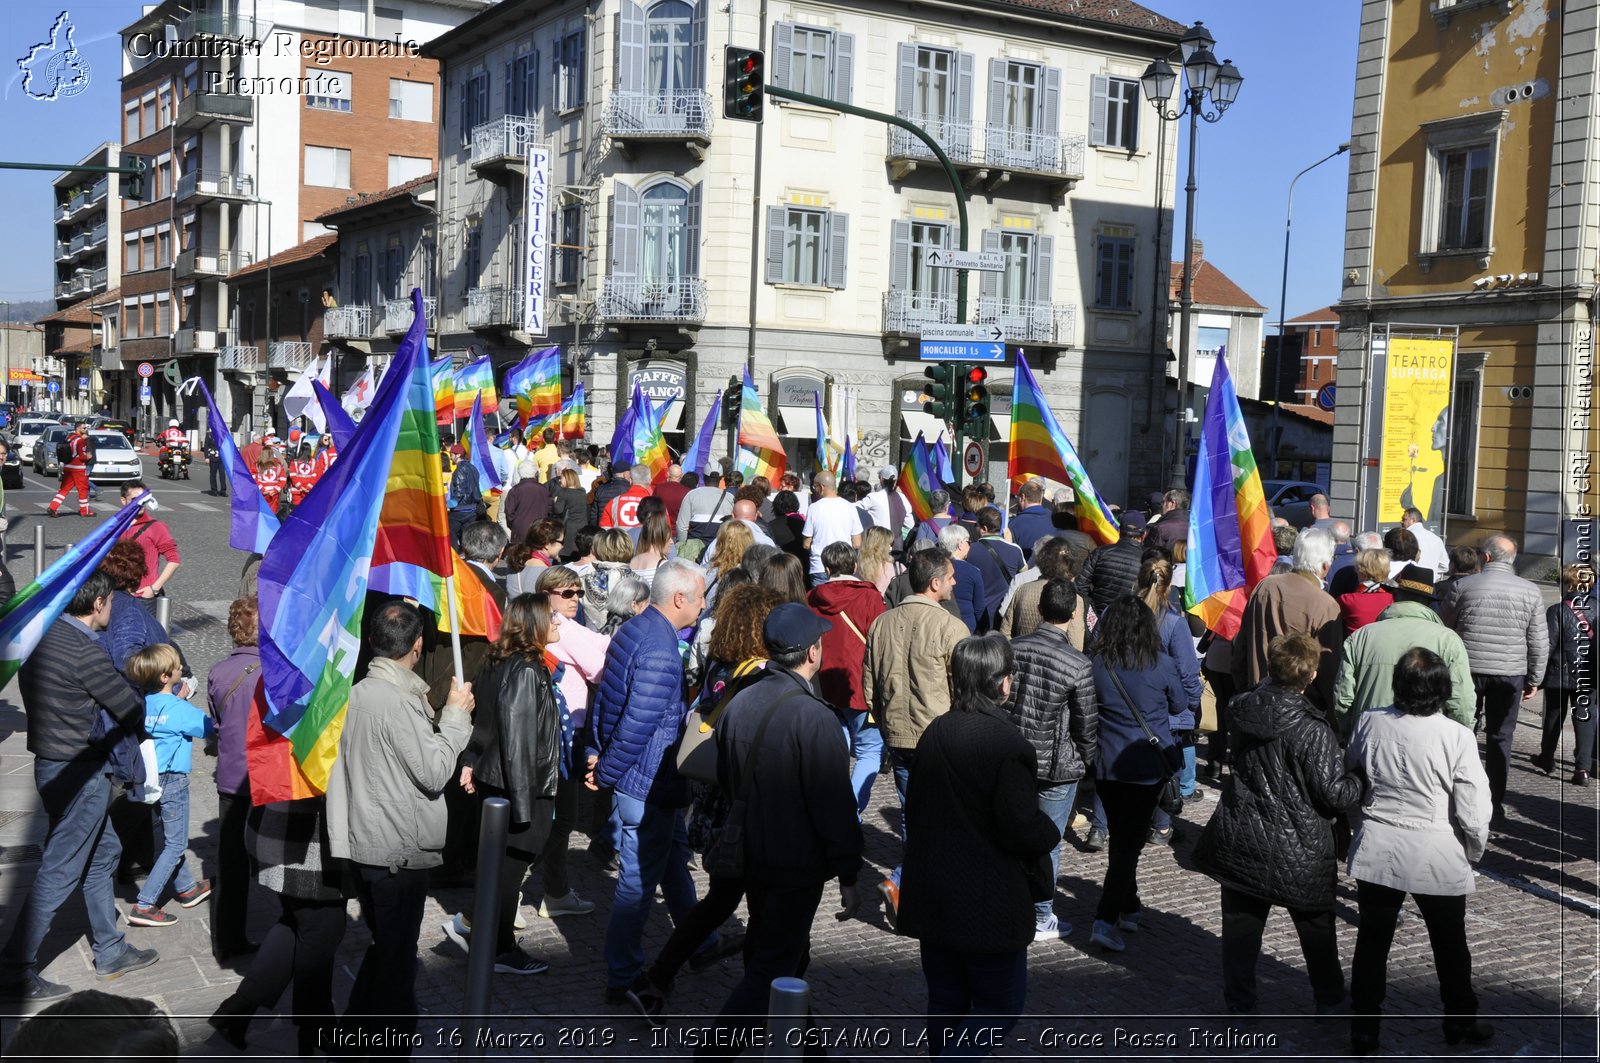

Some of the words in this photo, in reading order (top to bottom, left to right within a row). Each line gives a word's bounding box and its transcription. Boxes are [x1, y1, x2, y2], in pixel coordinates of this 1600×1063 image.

[527, 153, 545, 328] PASTICCERIA
[955, 259, 979, 268] Distretto
[980, 261, 1004, 270] Sanitario
[922, 327, 944, 338] piscina
[945, 328, 975, 337] comunale
[923, 345, 967, 355] MONCALIERI
[1392, 354, 1448, 369] TEATRO
[633, 370, 683, 385] CAFFE'
[1391, 367, 1448, 380] SUPERGA
